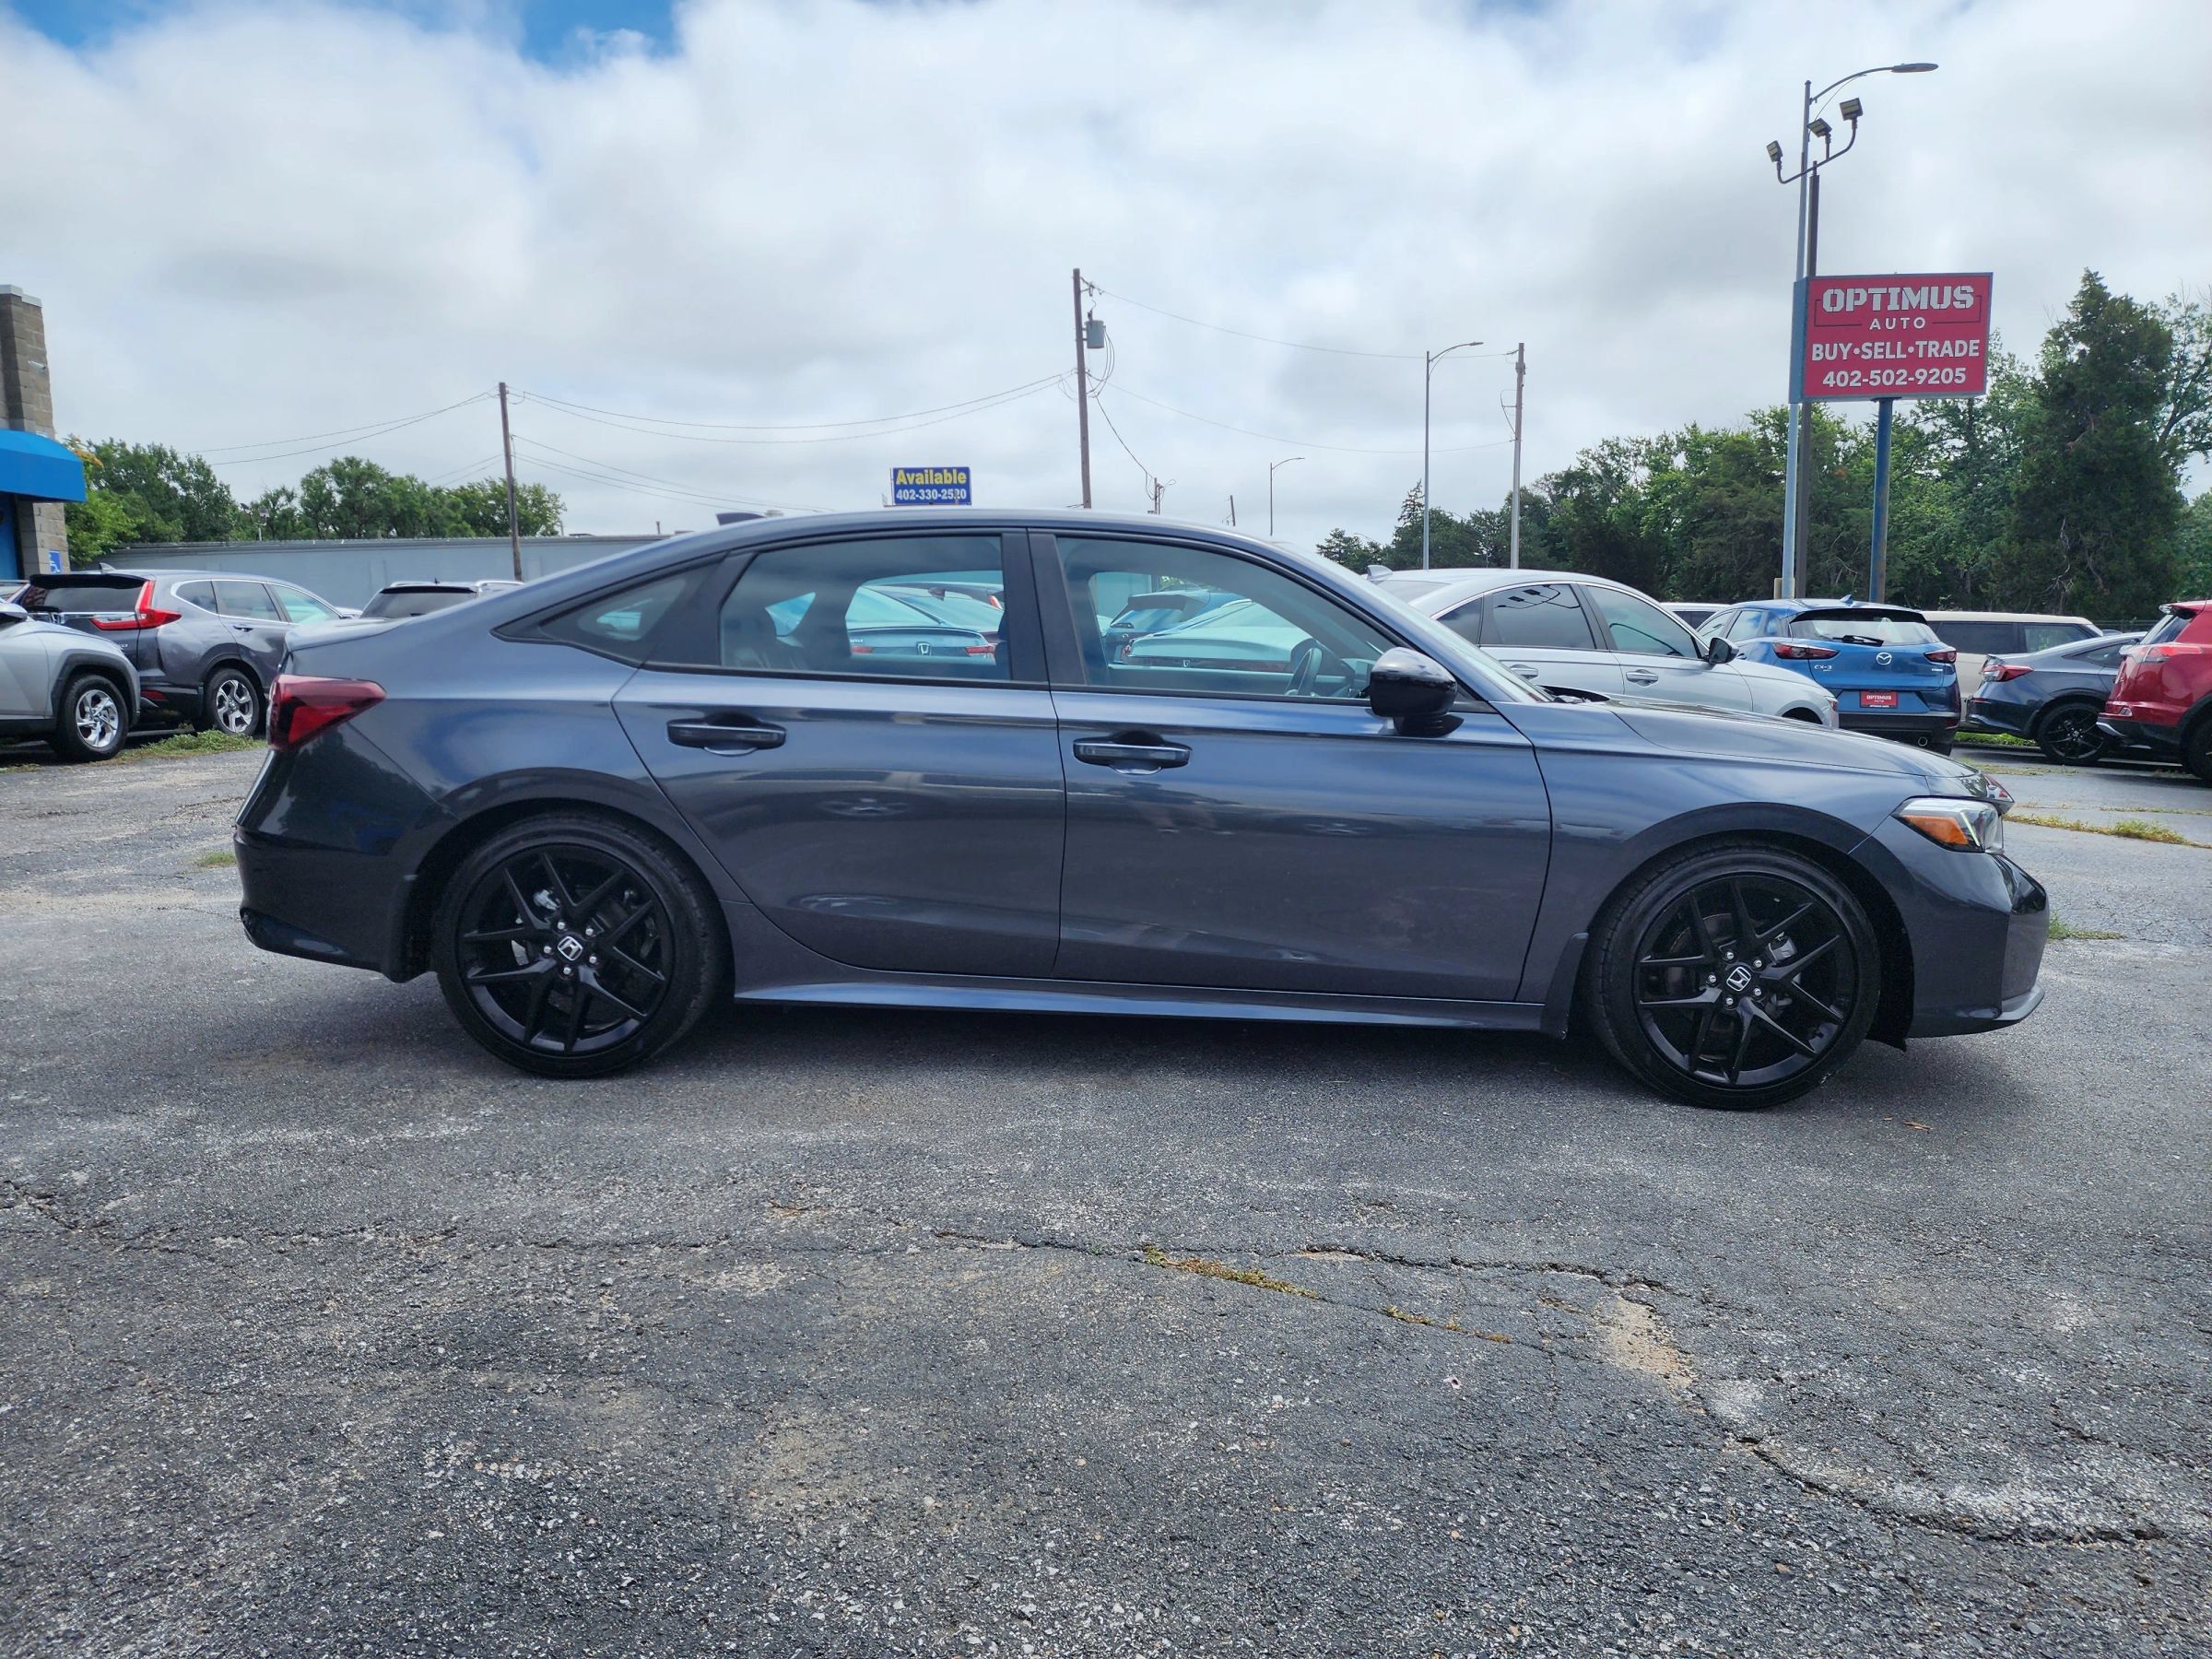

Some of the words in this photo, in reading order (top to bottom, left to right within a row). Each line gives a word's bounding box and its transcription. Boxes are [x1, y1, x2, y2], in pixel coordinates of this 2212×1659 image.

[1822, 285, 1974, 312] OPTIMUS
[1869, 316, 1926, 330] AUTO
[1822, 367, 1967, 387] 402-502-9205
[896, 468, 967, 485] Available
